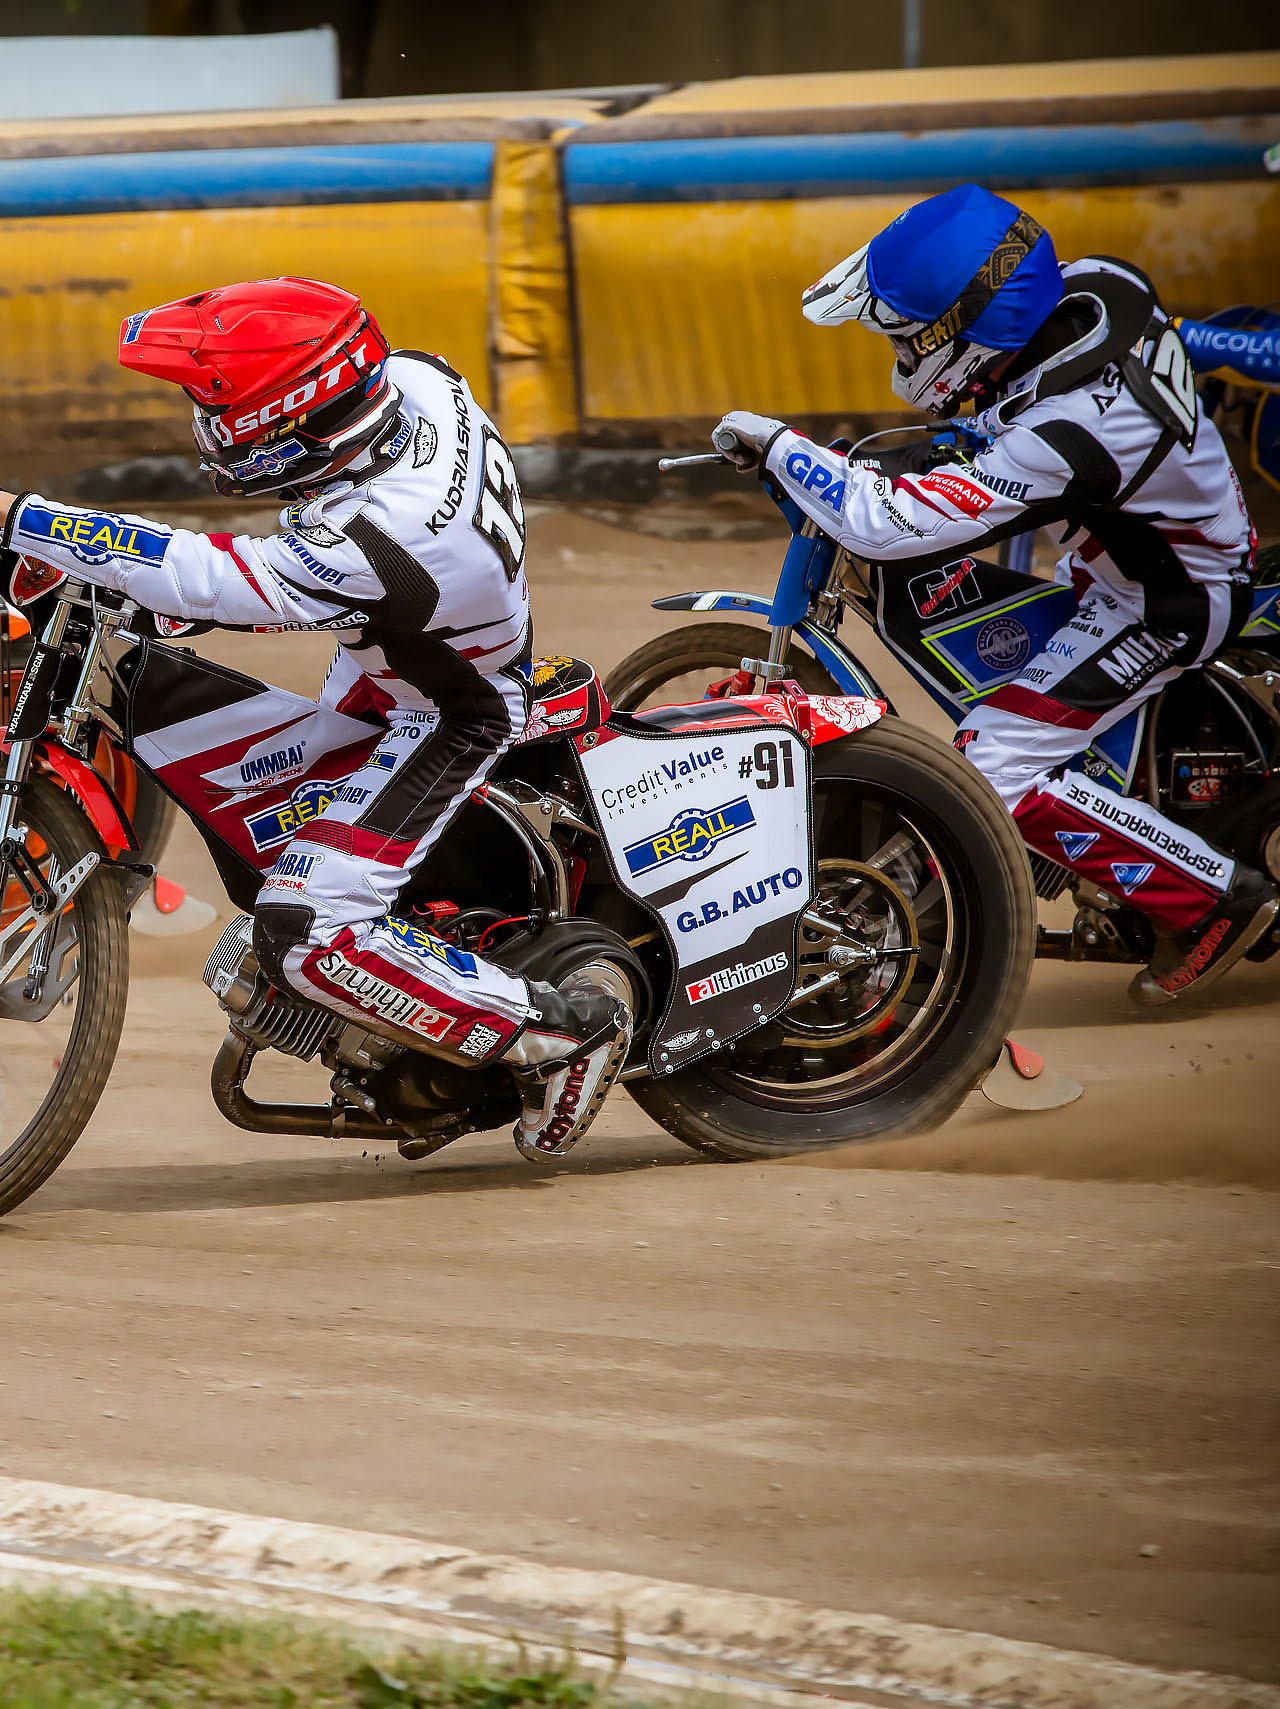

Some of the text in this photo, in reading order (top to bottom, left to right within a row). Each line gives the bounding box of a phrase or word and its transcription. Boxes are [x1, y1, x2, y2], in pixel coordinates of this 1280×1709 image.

[234, 342, 367, 436] SCOTT
[424, 379, 472, 537] KUDRIASHOV
[786, 452, 846, 512] GPA
[50, 516, 141, 555] REALL
[240, 744, 305, 783] UMMBA!
[608, 763, 729, 820] Investments
[738, 739, 795, 791] #91
[276, 789, 339, 833] REA
[652, 812, 735, 861] REALL
[1066, 783, 1224, 878] ASPGRENRACING.SE
[676, 867, 803, 933] G.B. AUTO
[698, 952, 789, 999] althimus
[536, 1058, 591, 1152] daytona
